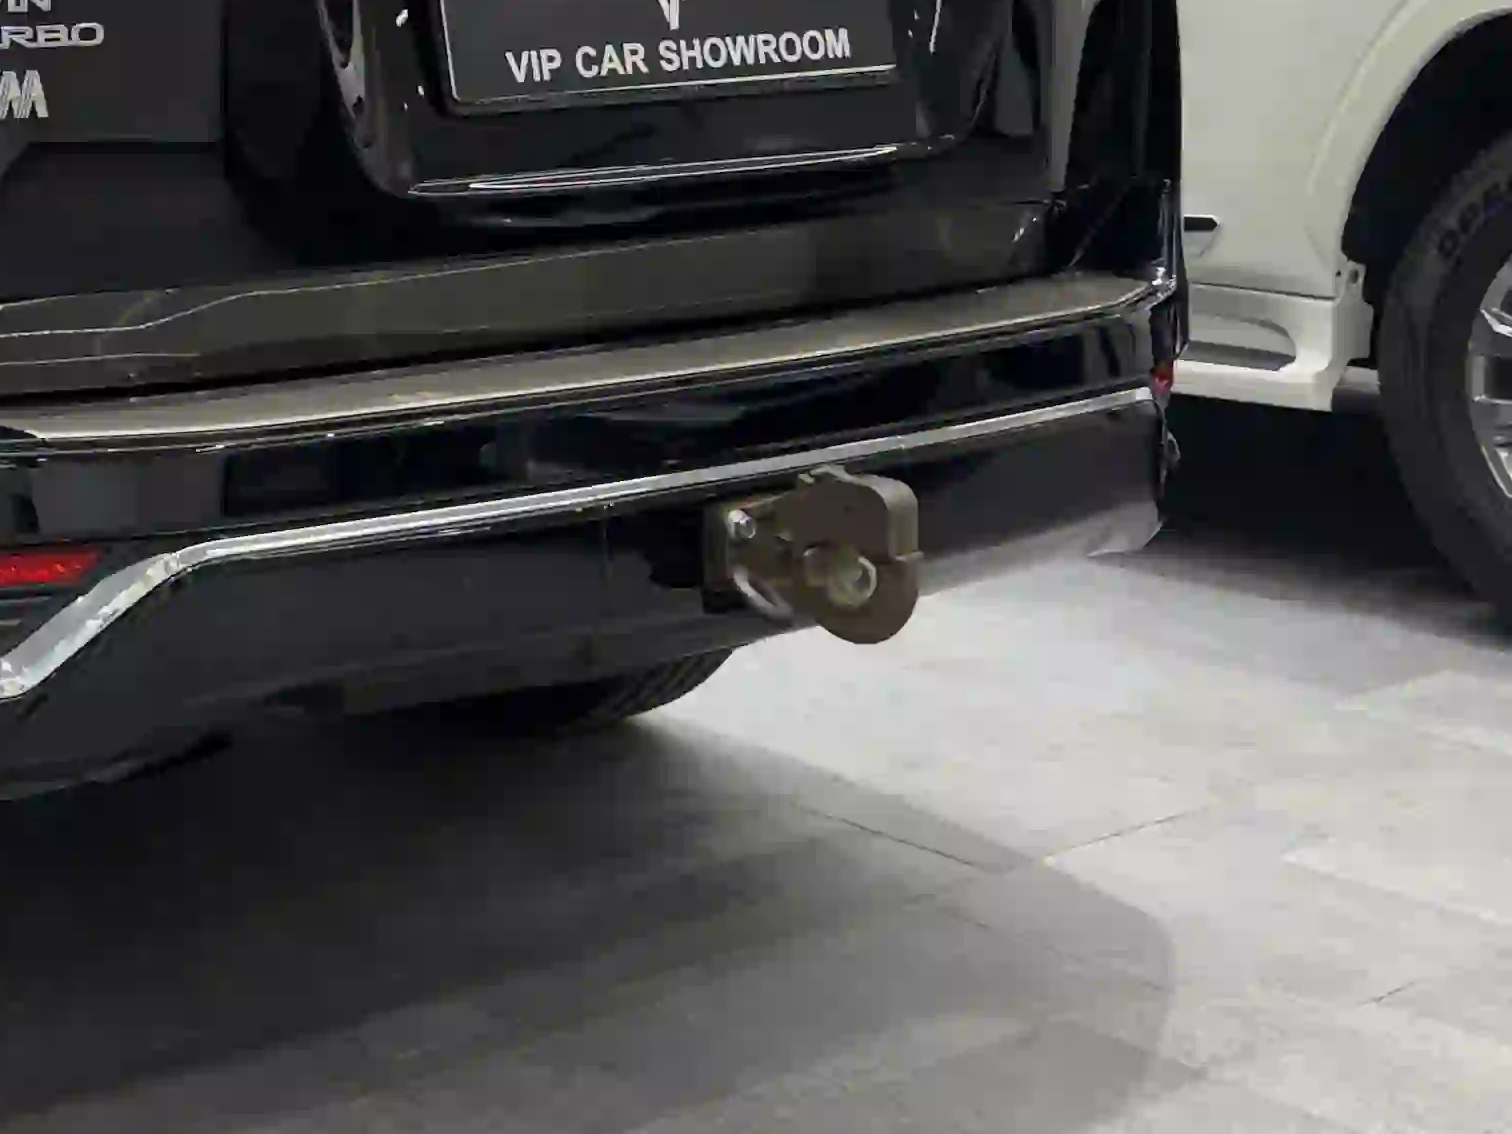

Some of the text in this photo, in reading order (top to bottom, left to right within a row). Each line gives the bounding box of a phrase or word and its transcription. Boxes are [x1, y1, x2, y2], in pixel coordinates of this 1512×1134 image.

[505, 28, 852, 84] VIP CAR SHOWROOM
